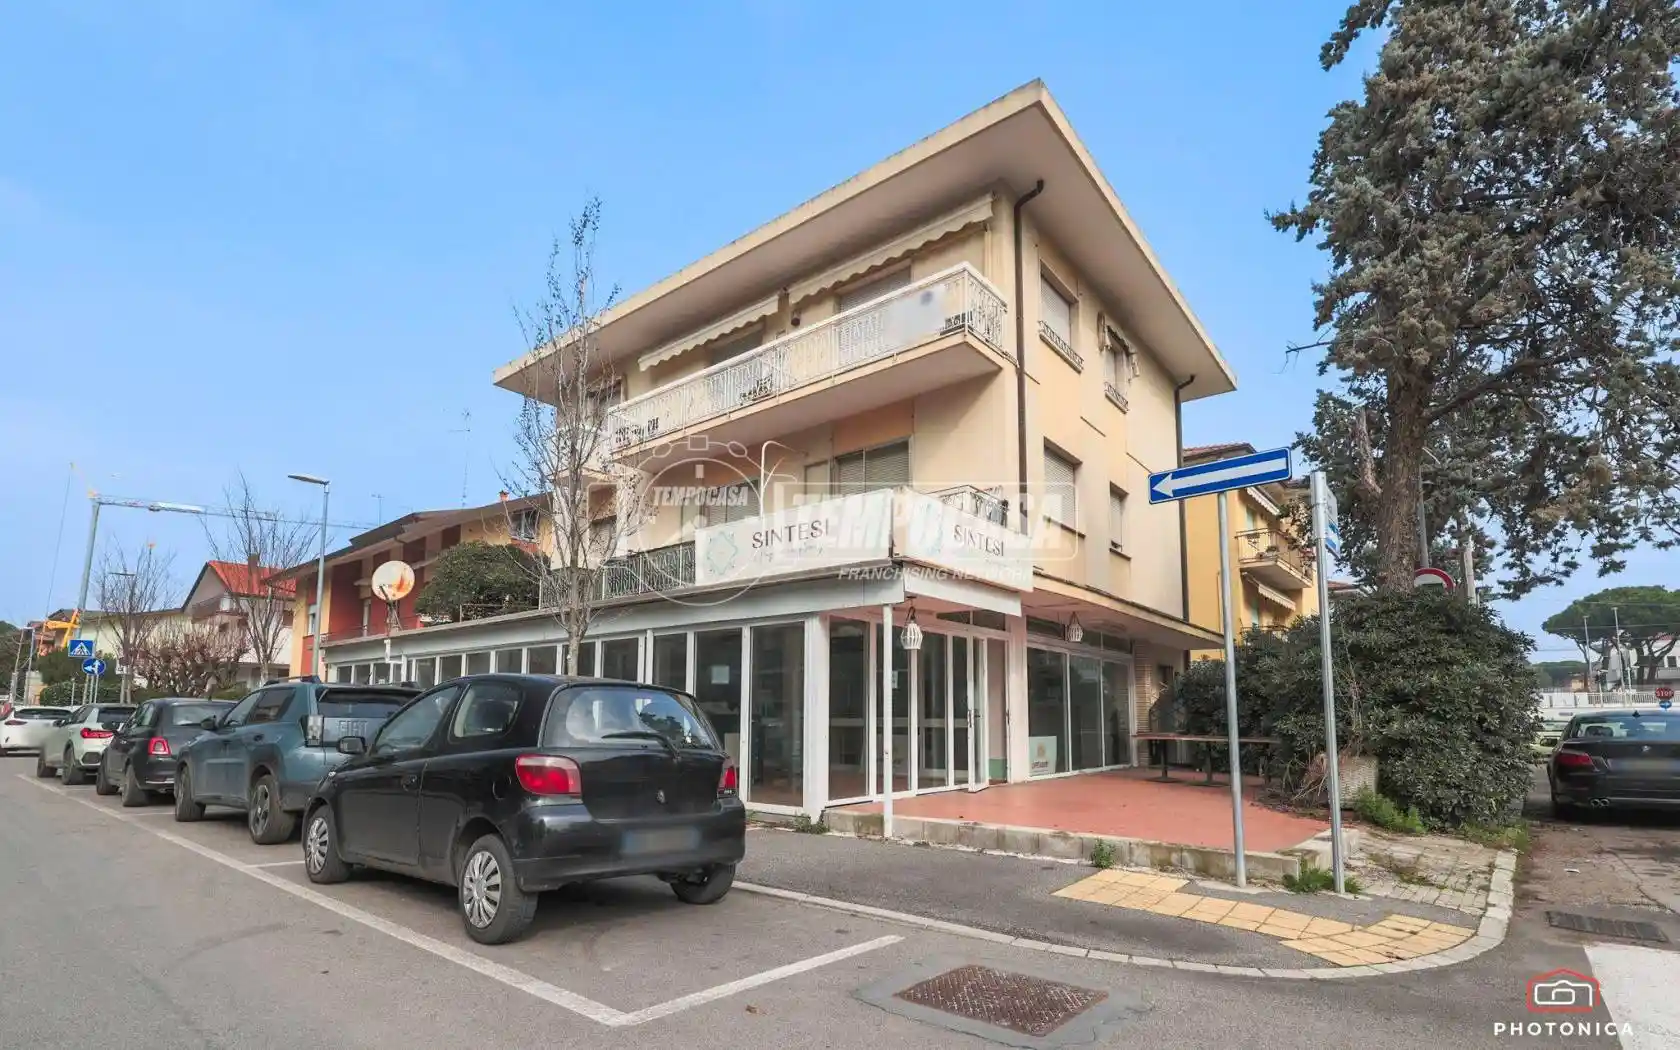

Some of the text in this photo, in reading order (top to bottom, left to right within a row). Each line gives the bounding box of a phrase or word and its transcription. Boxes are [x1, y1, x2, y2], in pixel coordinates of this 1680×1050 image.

[752, 518, 829, 549] SINTESI
[953, 523, 1004, 557] SINTESI
[339, 720, 369, 737] FIAT
